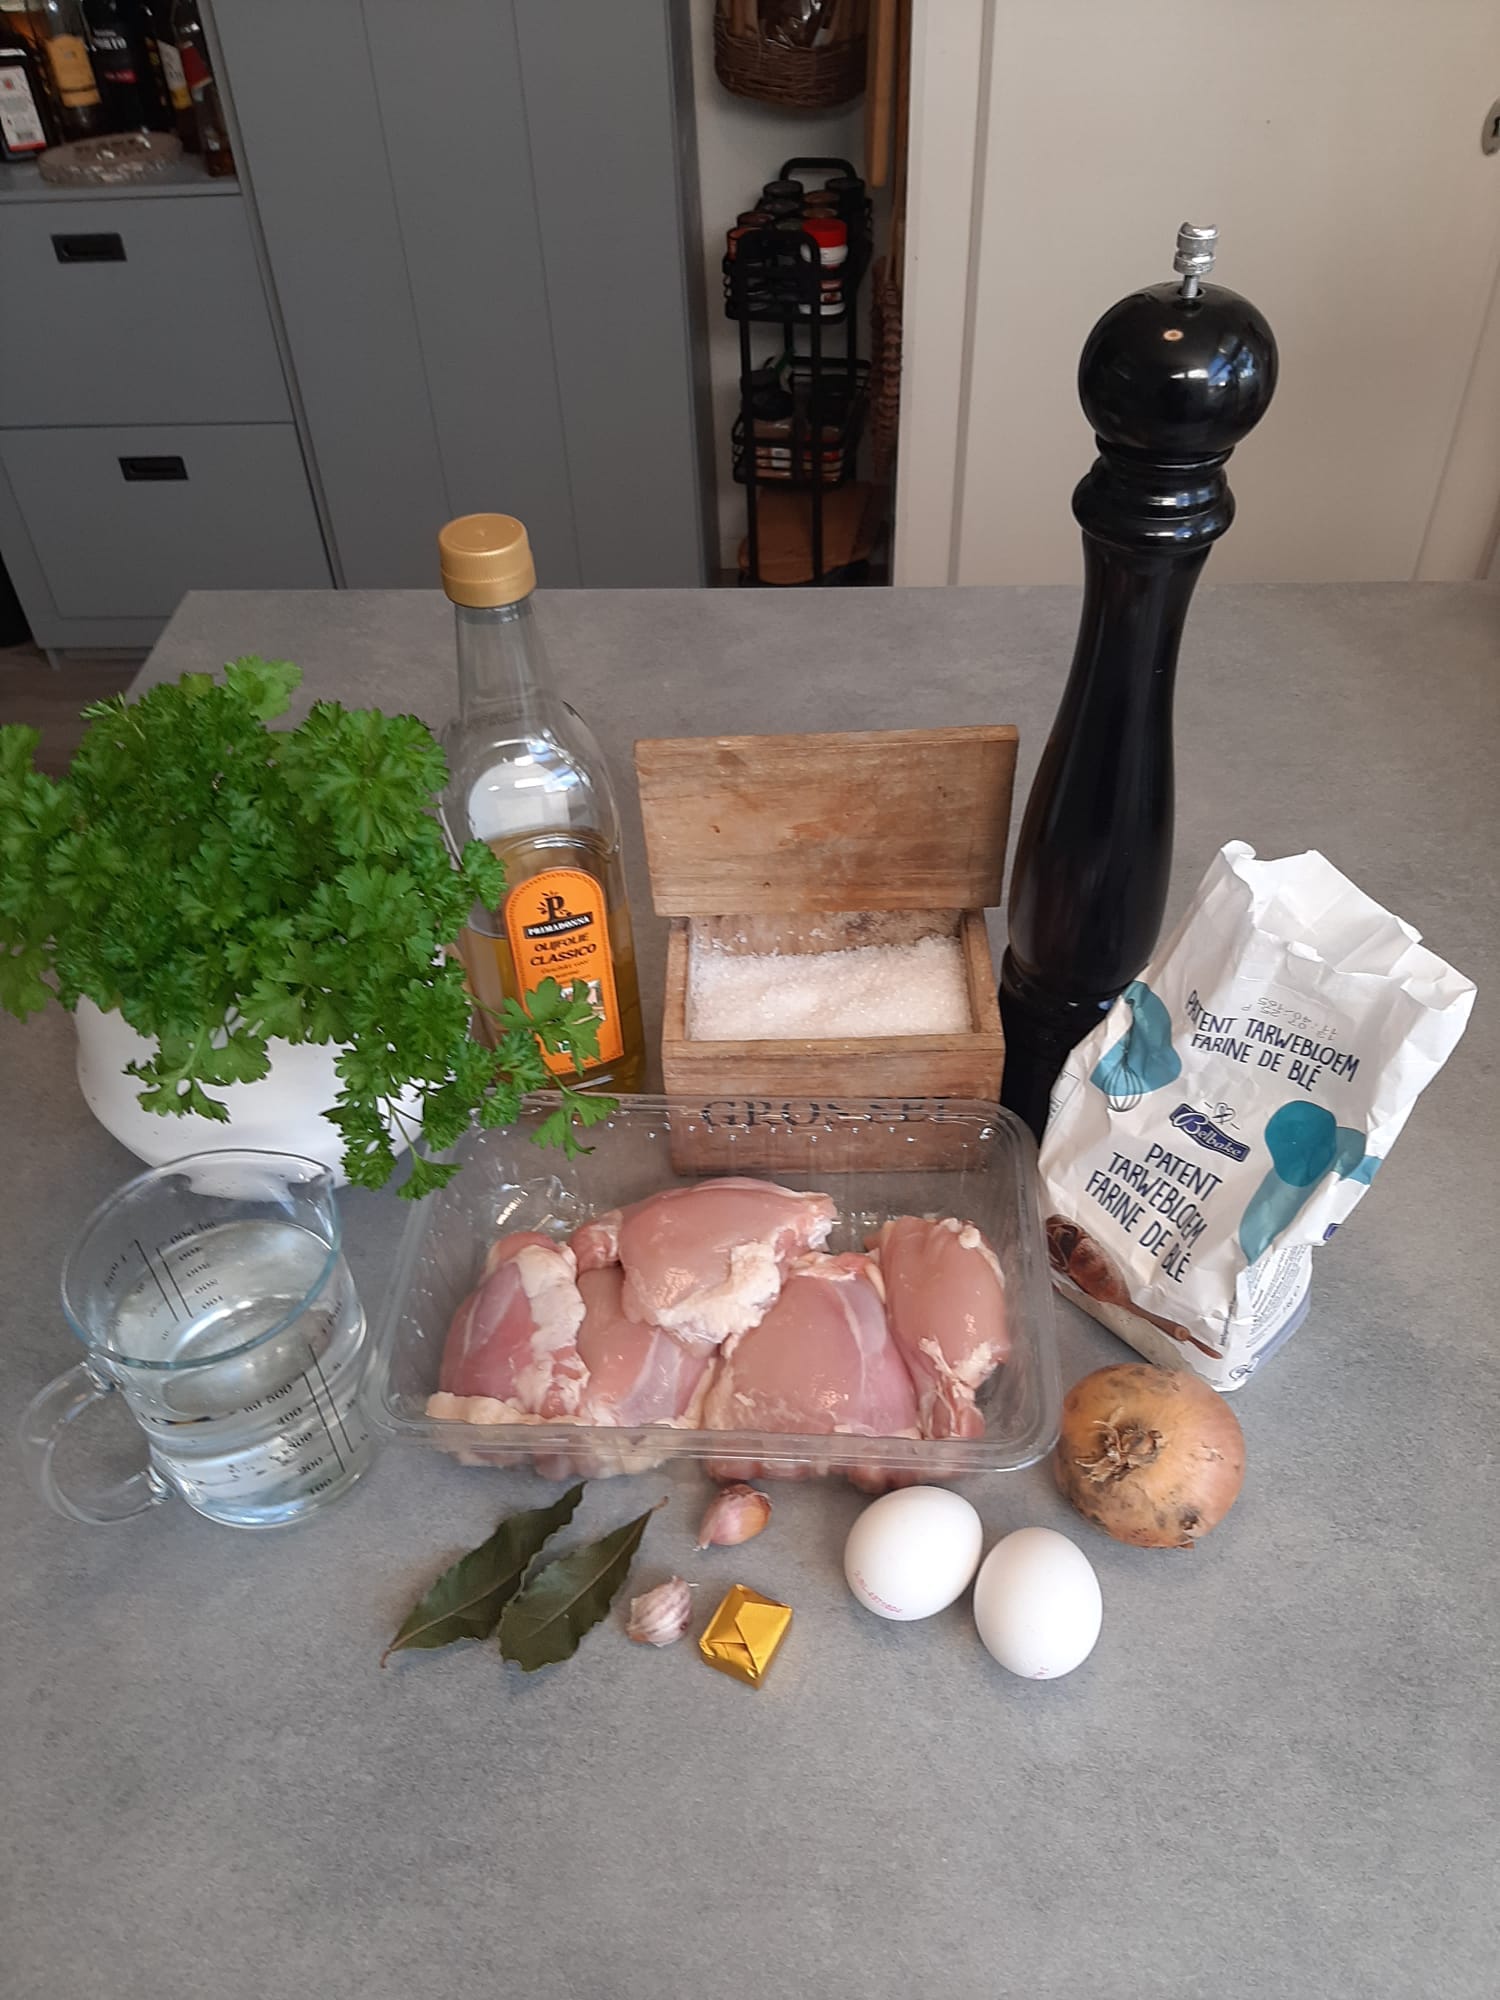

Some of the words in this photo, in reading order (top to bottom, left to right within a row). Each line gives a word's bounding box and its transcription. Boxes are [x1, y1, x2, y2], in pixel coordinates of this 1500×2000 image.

[527, 914, 591, 936] PRIMADONNA
[530, 943, 597, 967] CLASSICO
[1185, 989, 1238, 1035] PATENT
[1245, 1018, 1360, 1083] TARWEBLOEM
[1191, 1033, 1254, 1063] FARINE
[1257, 1049, 1285, 1073] DE
[1287, 1059, 1322, 1092] BLÉ
[1173, 1112, 1243, 1157] Belbake
[1108, 1152, 1207, 1248] TARWEBLOEM
[1145, 1142, 1222, 1201] PATENT
[1085, 1170, 1146, 1233] FARINE
[1139, 1220, 1173, 1257] DE
[1161, 1242, 1192, 1284] BLÉ
